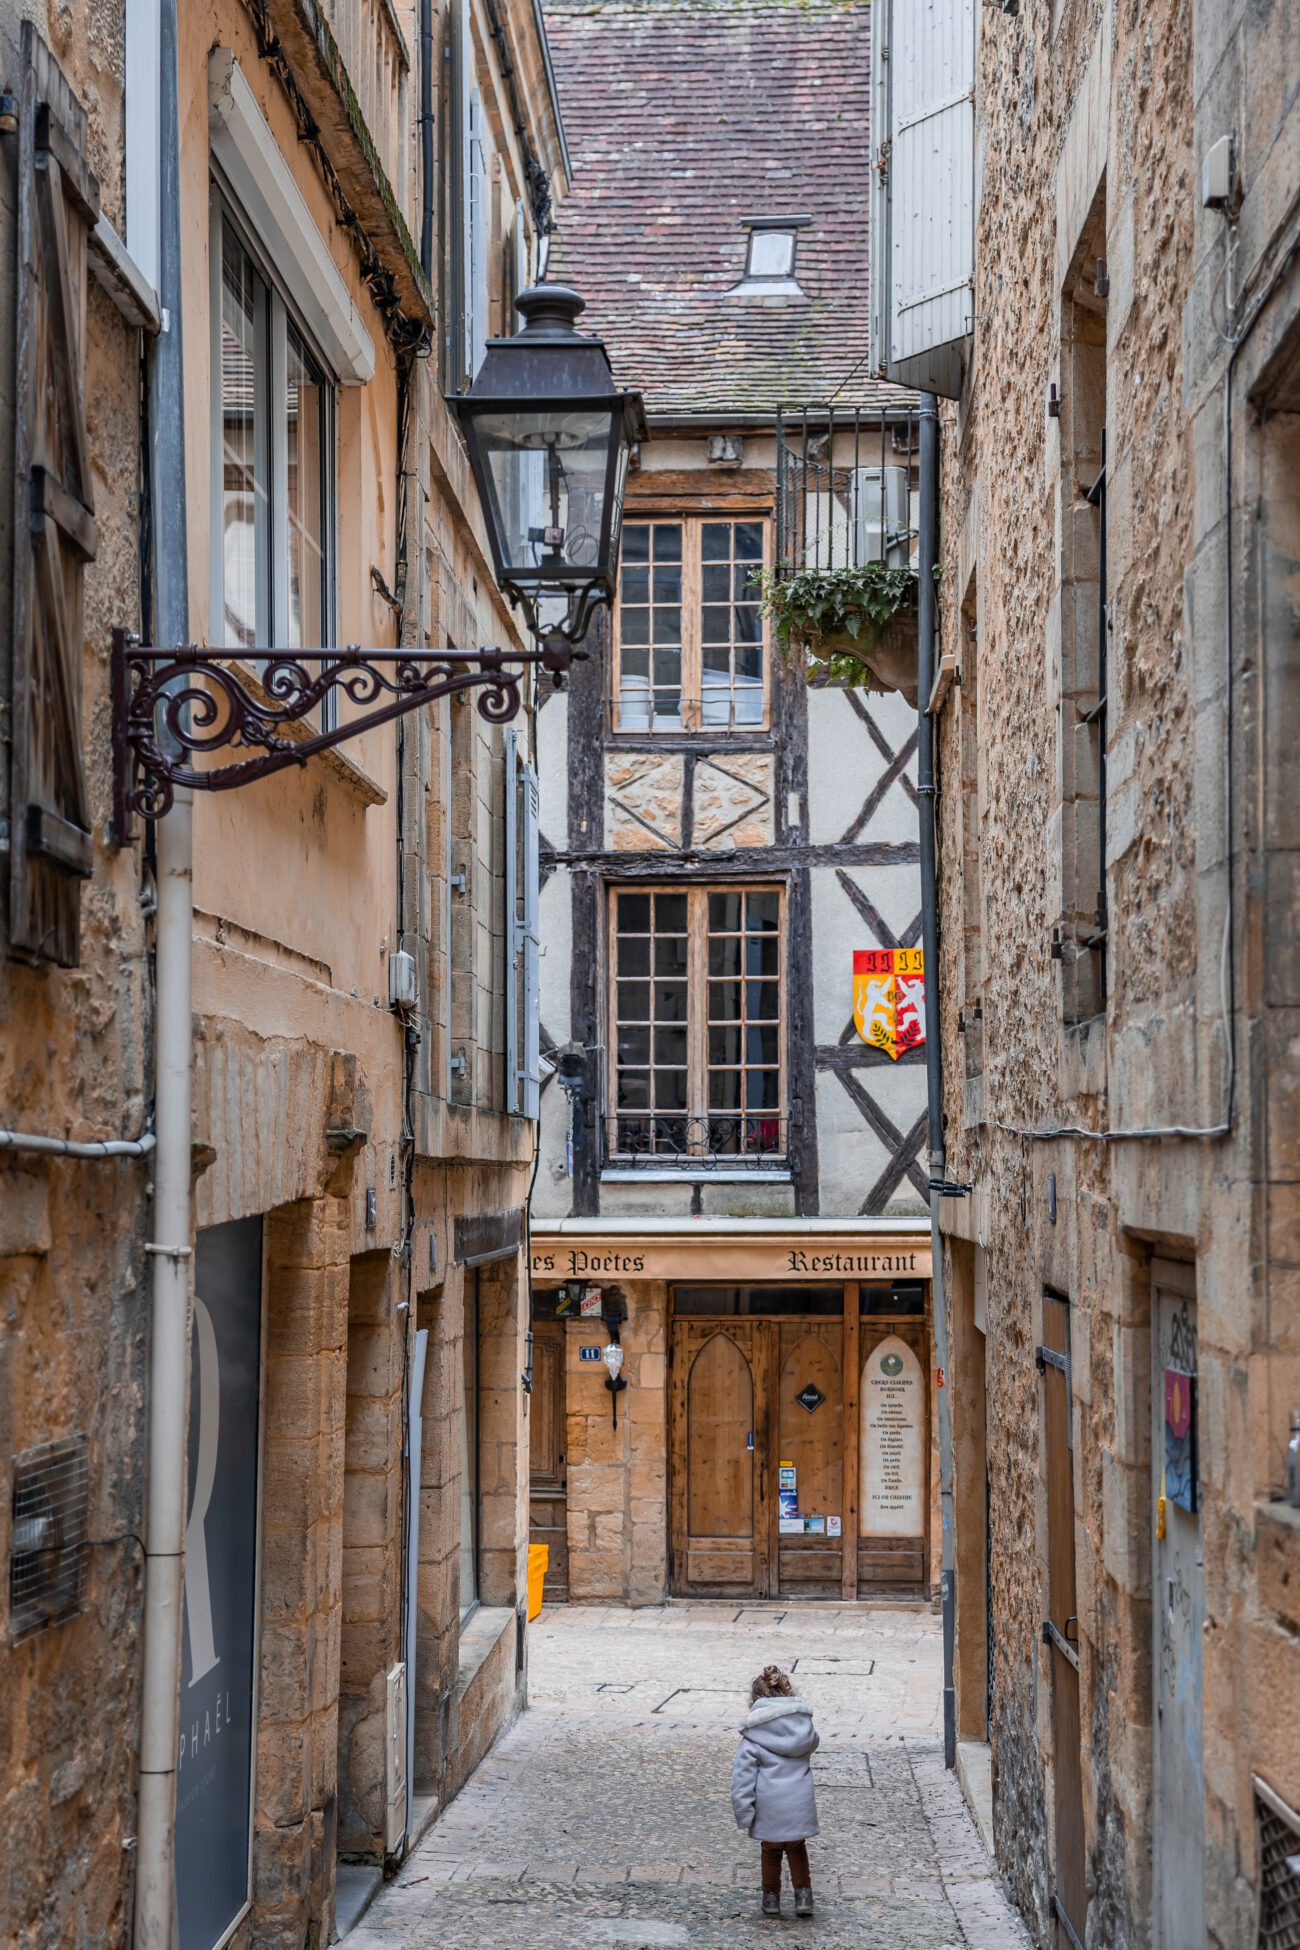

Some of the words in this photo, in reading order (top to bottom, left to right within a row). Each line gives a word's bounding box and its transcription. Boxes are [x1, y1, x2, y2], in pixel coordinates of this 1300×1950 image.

[533, 1253, 555, 1271] es
[567, 1250, 645, 1276] Poètes
[787, 1250, 917, 1272] Restaurant
[585, 1349, 596, 1359] 11
[179, 1691, 231, 1770] PHAËL
